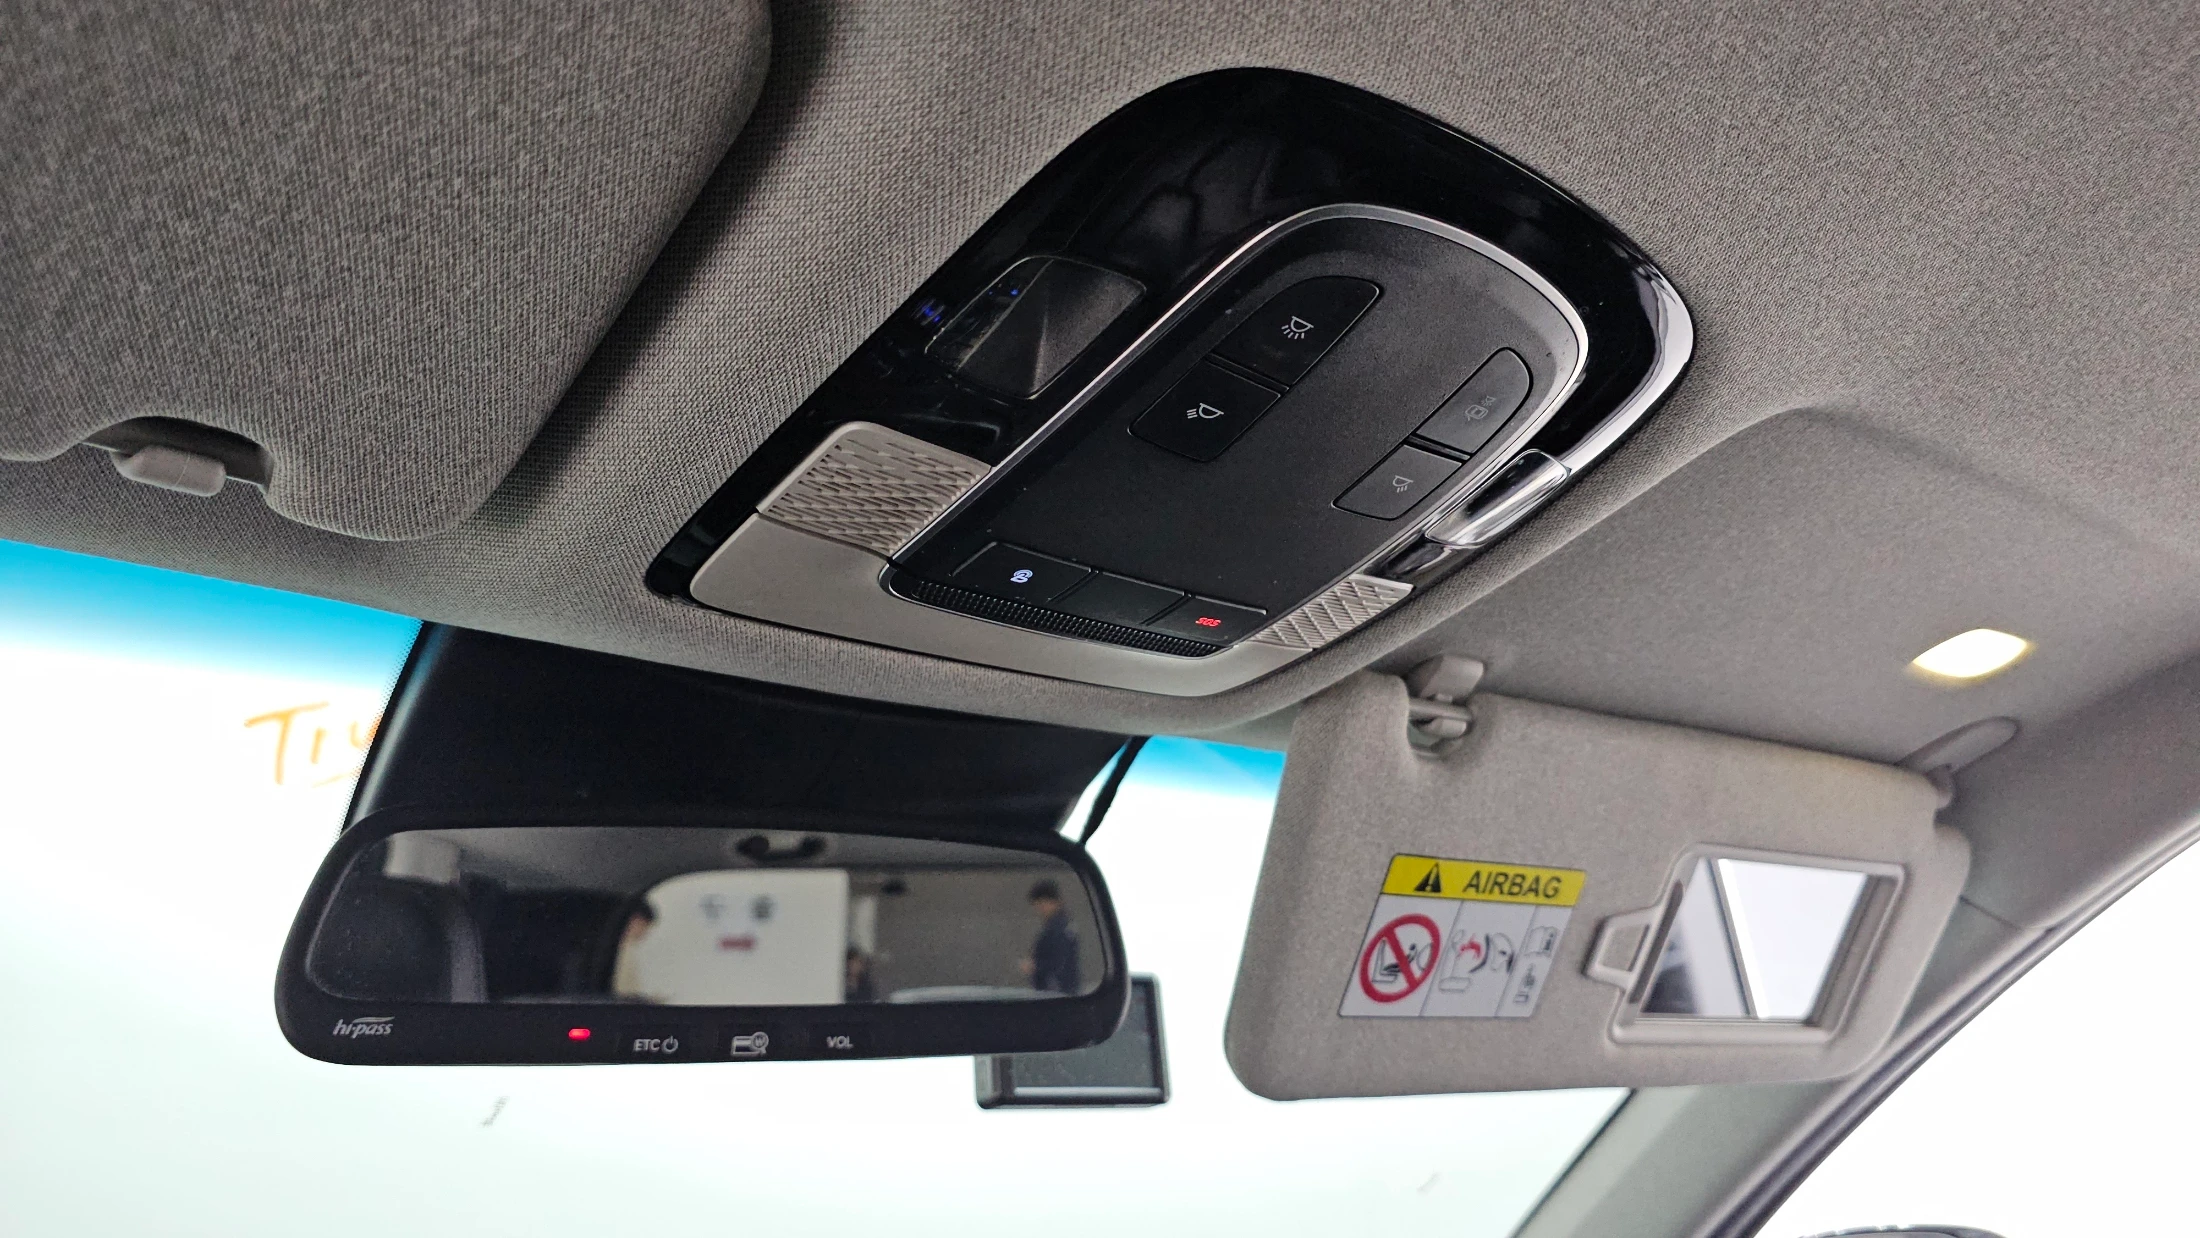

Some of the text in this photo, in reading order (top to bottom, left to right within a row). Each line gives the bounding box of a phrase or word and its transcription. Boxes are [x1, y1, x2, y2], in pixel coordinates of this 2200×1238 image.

[1195, 617, 1221, 627] SOS
[1462, 870, 1562, 899] AIRBAG
[633, 1038, 661, 1052] ETC
[826, 1035, 854, 1049] VOL
